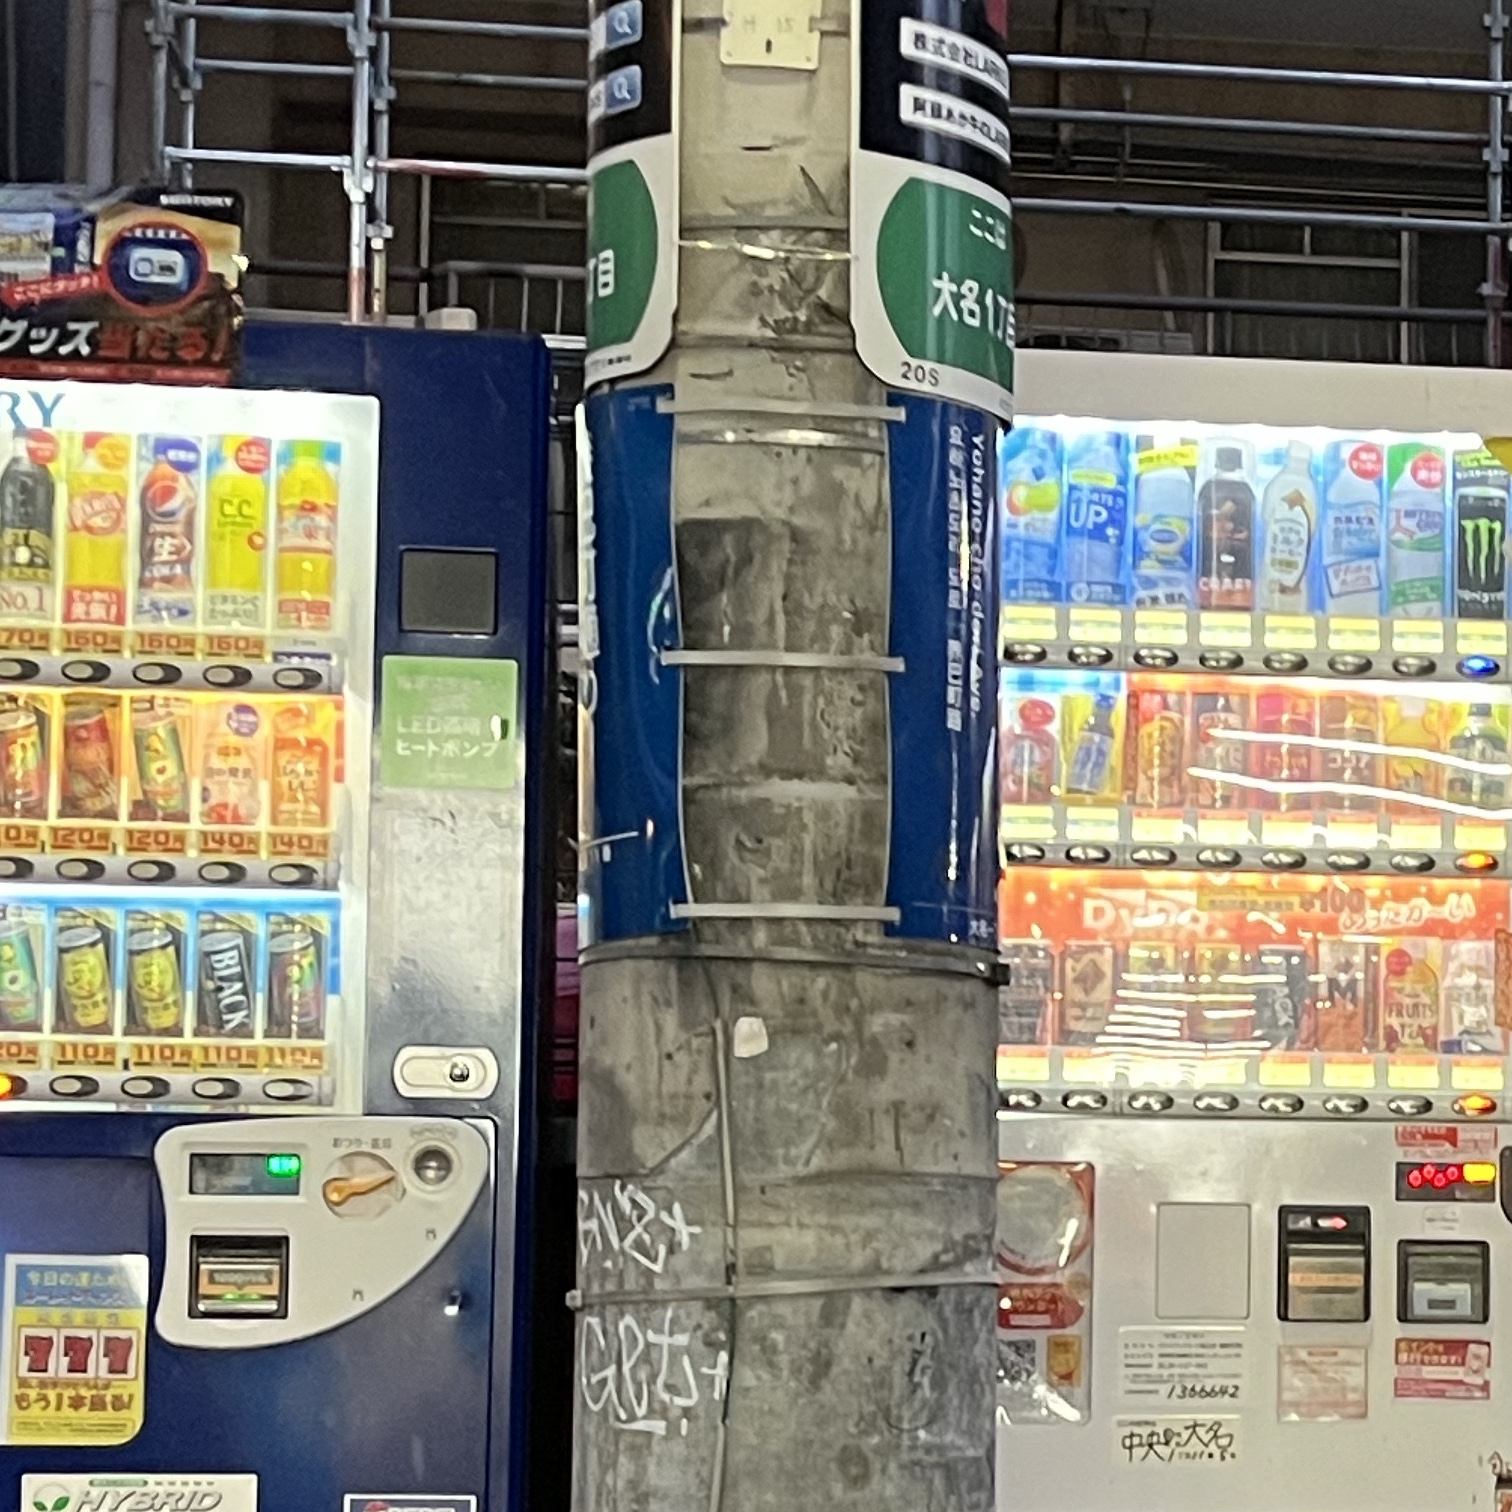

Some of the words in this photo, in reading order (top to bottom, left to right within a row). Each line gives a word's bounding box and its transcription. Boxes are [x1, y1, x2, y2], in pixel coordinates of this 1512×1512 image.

[900, 361, 940, 387] 20S
[1070, 503, 1108, 530] UP
[395, 738, 500, 758] ヒートポンプ
[209, 949, 250, 1032] BLACK
